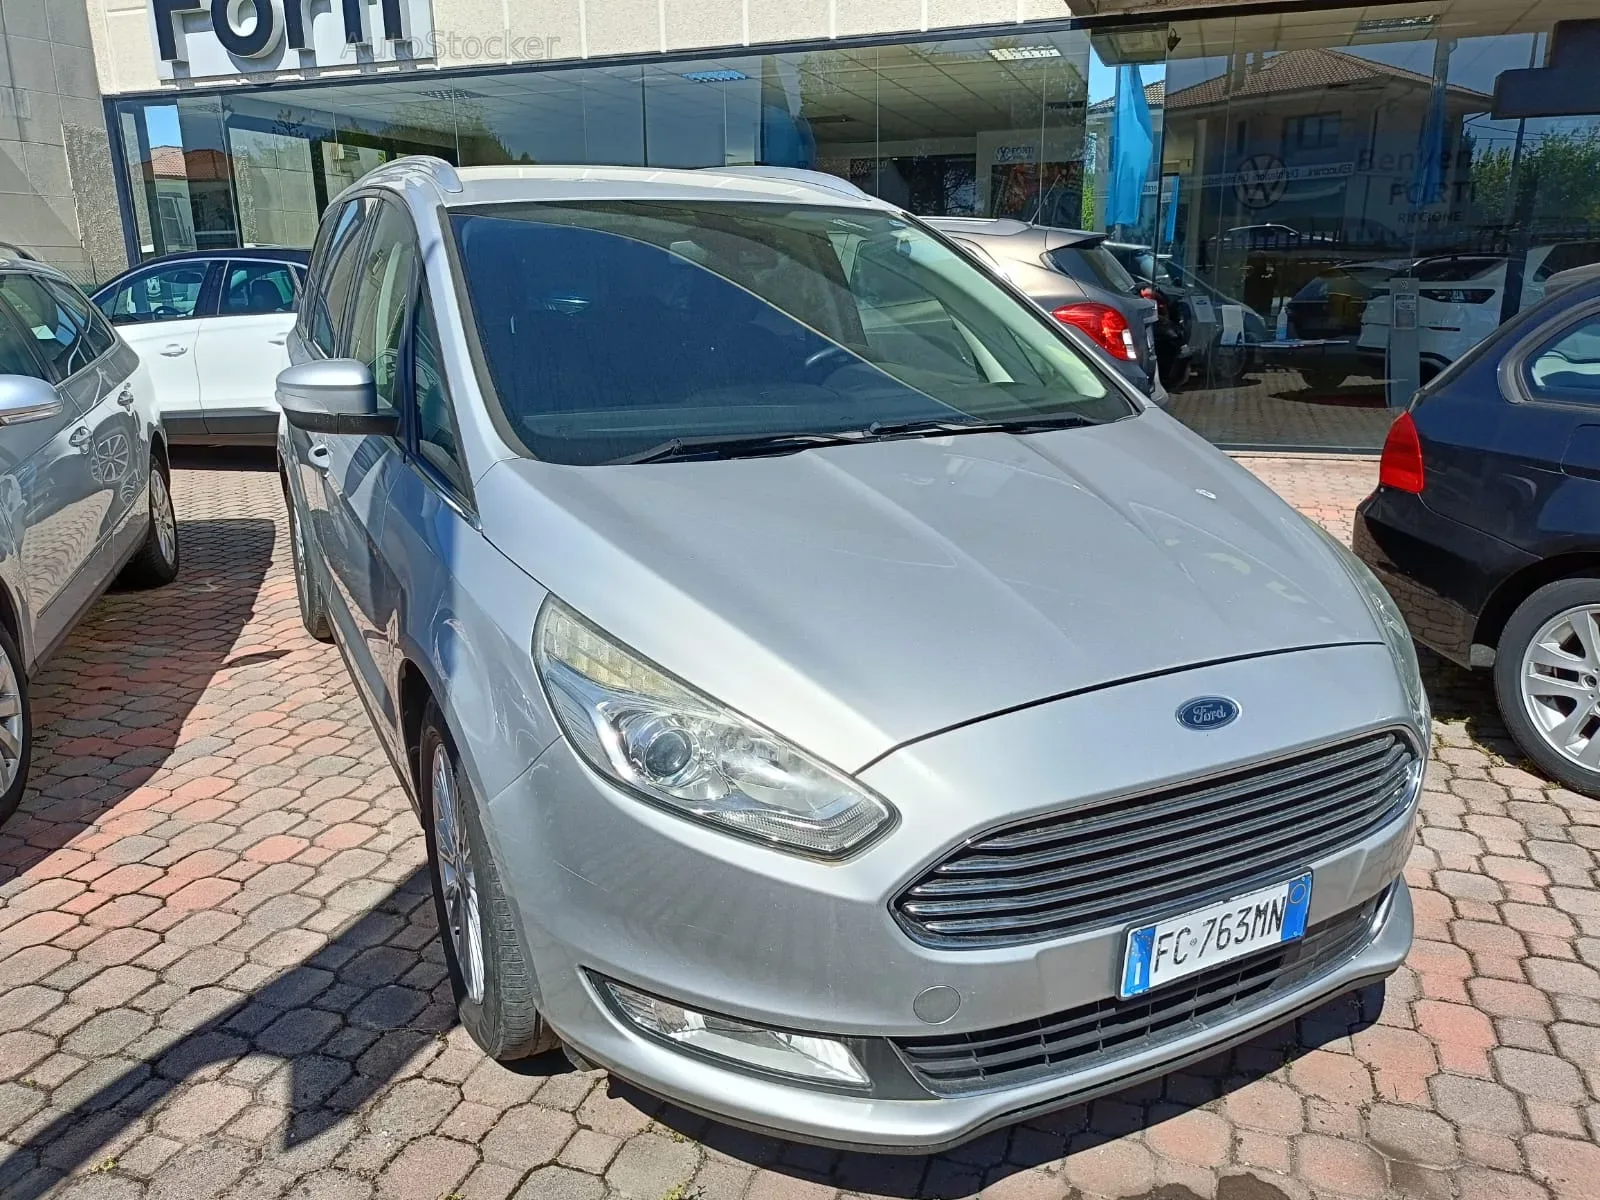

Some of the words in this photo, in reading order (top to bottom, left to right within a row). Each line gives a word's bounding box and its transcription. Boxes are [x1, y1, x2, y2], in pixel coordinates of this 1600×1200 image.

[1192, 703, 1227, 724] Ford
[1154, 925, 1191, 973] FC
[1196, 896, 1286, 960] 763MN
